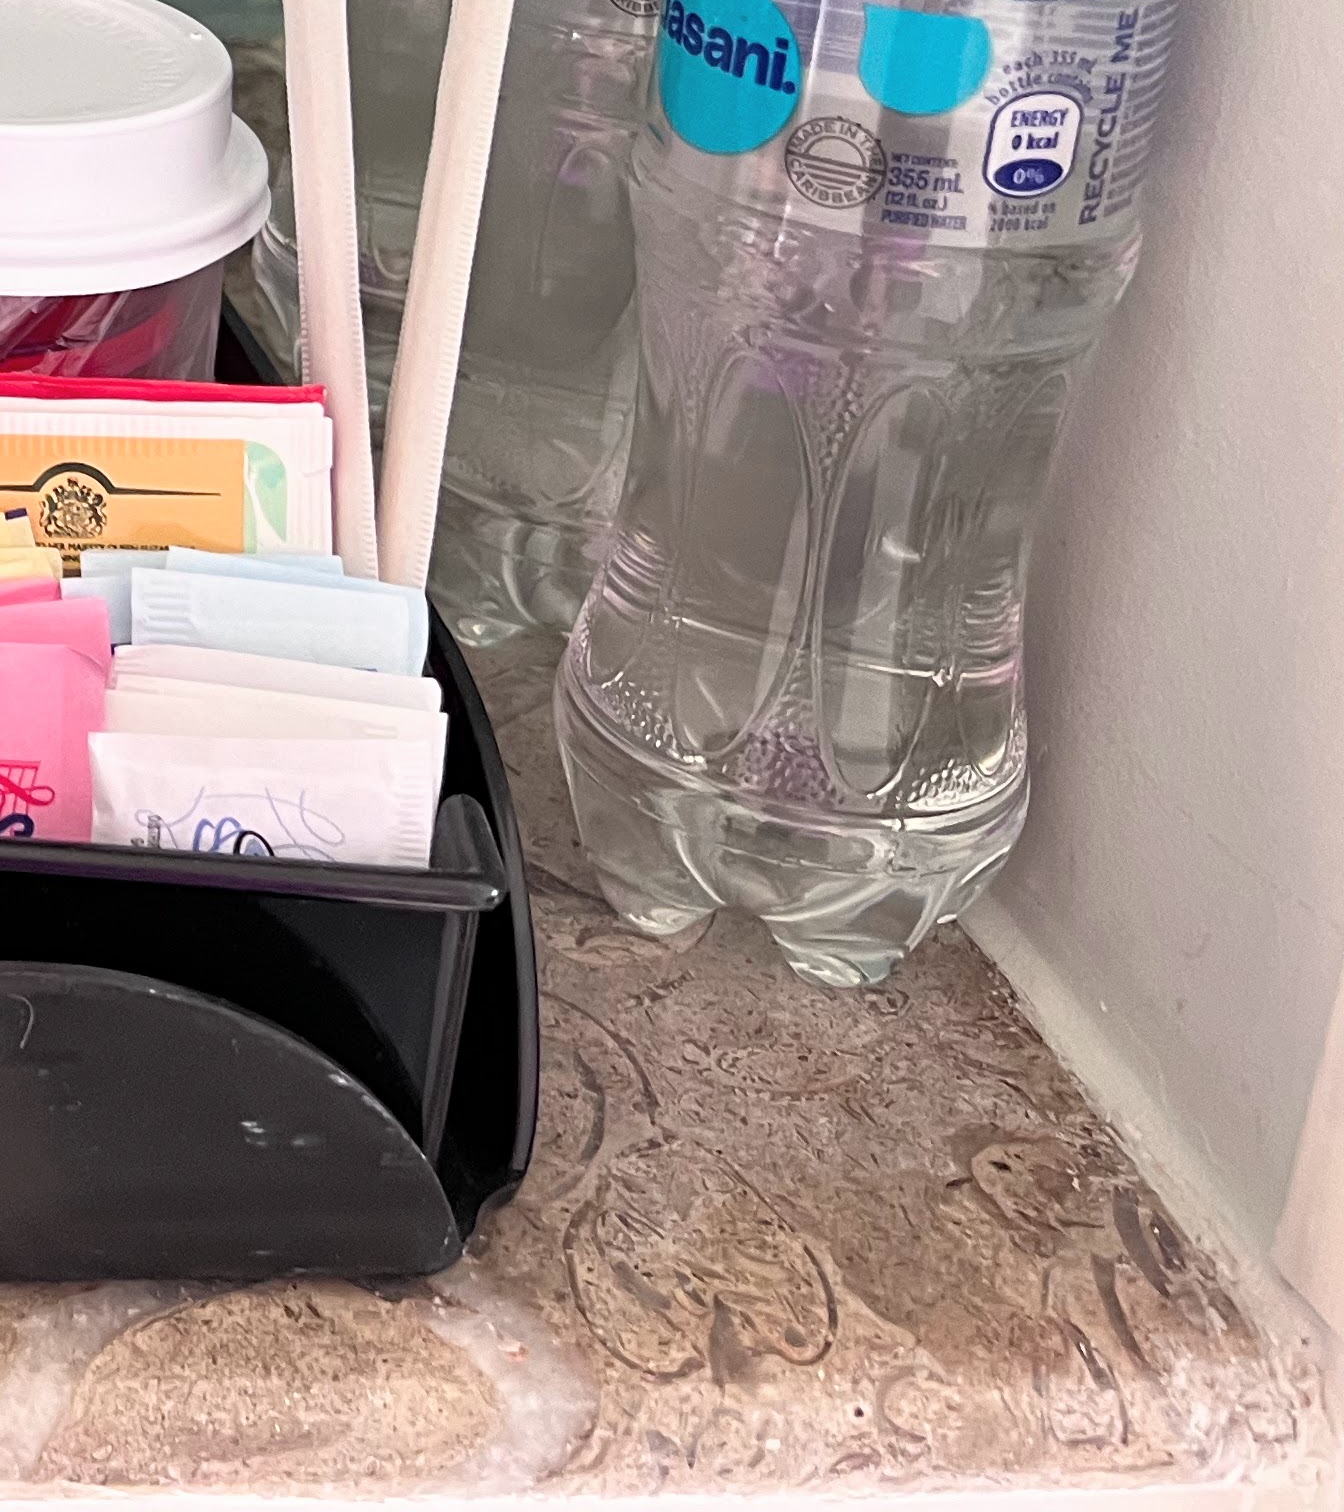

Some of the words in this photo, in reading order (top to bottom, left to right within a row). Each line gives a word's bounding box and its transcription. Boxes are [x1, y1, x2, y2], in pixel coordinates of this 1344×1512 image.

[1010, 108, 1069, 128] ENERGY
[1079, 72, 1127, 225] RECYCLE
[1110, 6, 1139, 63] ME
[788, 122, 835, 152] MADE
[839, 123, 859, 141] IN
[1012, 134, 1022, 151] 0
[1026, 132, 1059, 150] kcal
[888, 166, 930, 191] 355
[1013, 167, 1045, 185] 0%
